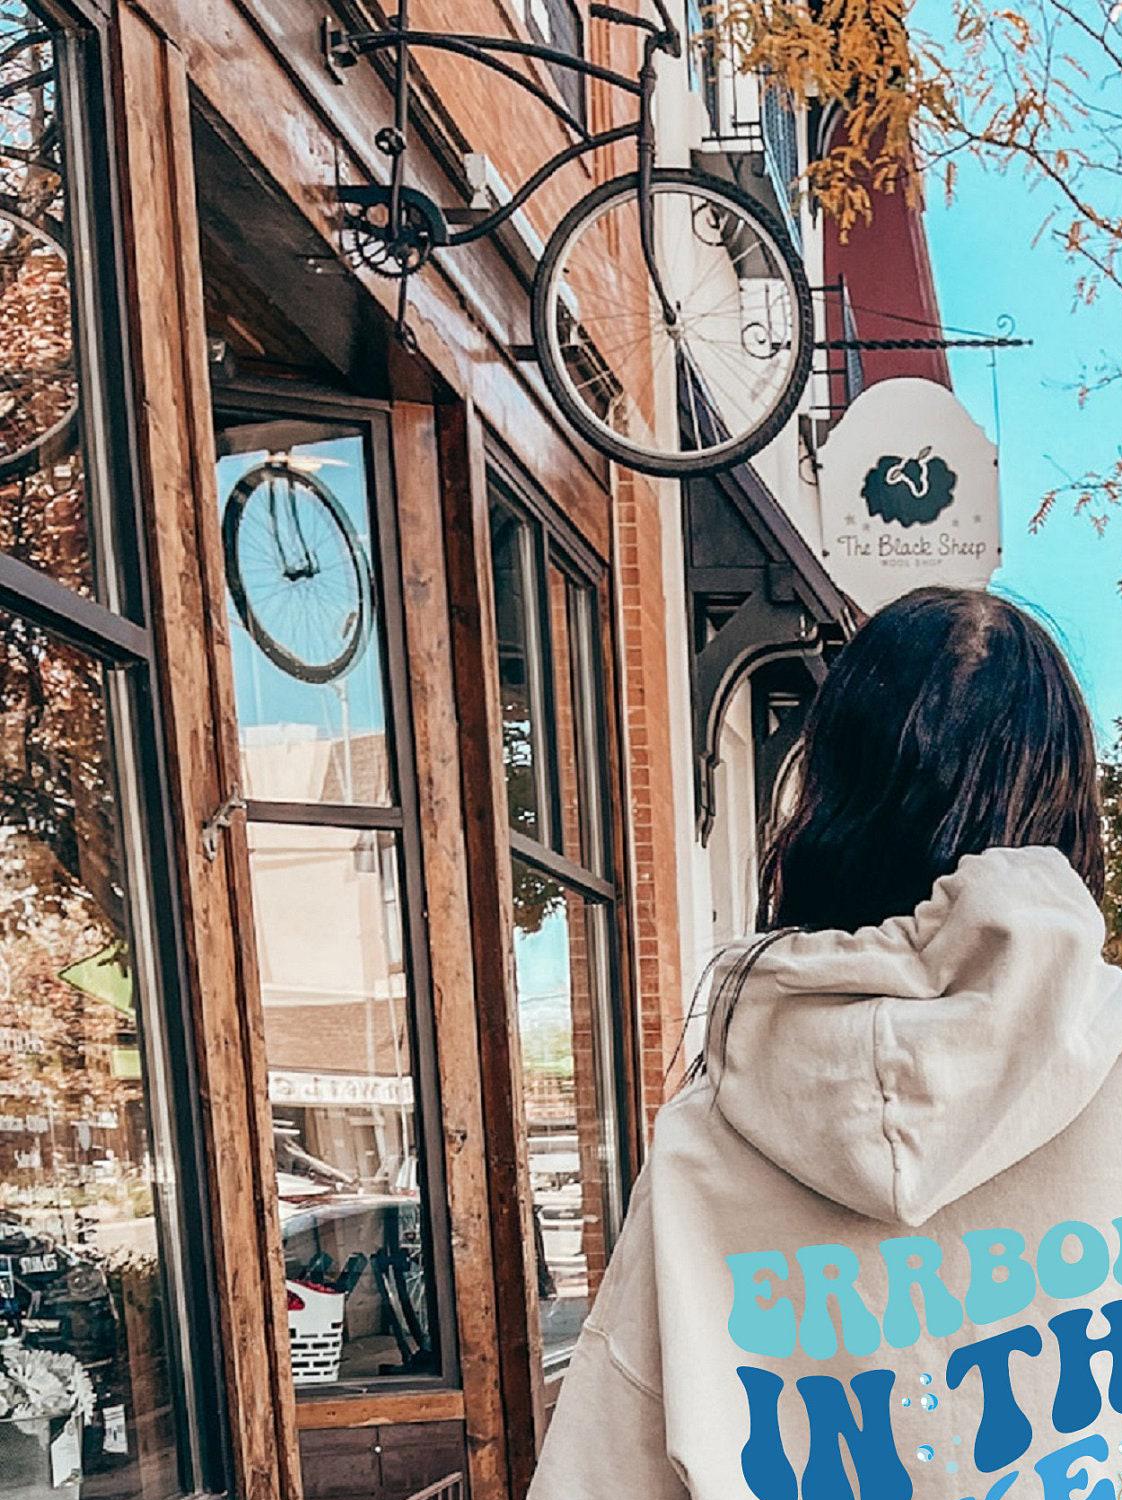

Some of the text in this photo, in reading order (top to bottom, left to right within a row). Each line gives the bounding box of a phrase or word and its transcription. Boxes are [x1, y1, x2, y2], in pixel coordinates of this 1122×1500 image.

[837, 532, 987, 559] The Black Sheep
